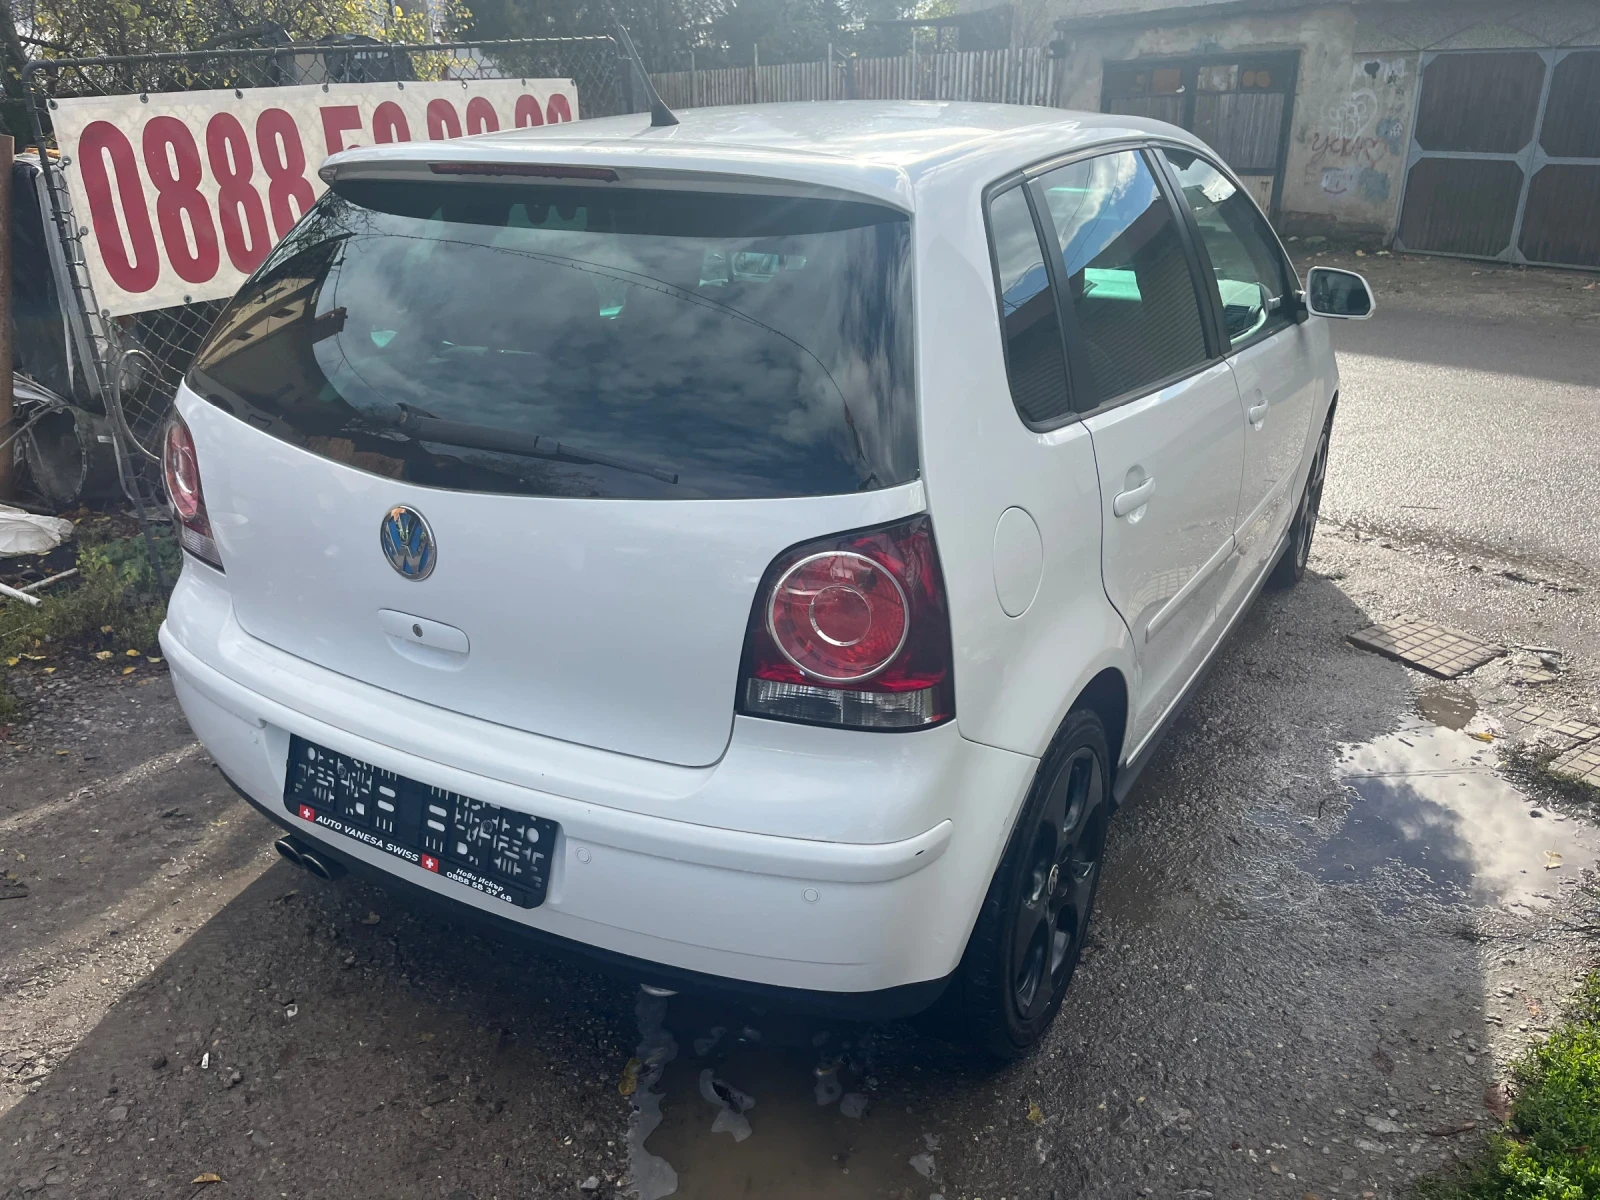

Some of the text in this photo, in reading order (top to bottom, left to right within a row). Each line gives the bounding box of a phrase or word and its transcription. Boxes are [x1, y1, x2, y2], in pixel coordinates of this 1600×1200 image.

[78, 107, 315, 293] 0888
[315, 815, 420, 862] AUTO VANESA SWISS
[446, 871, 470, 885] 0888
[485, 887, 498, 896] 39
[499, 893, 512, 903] 68
